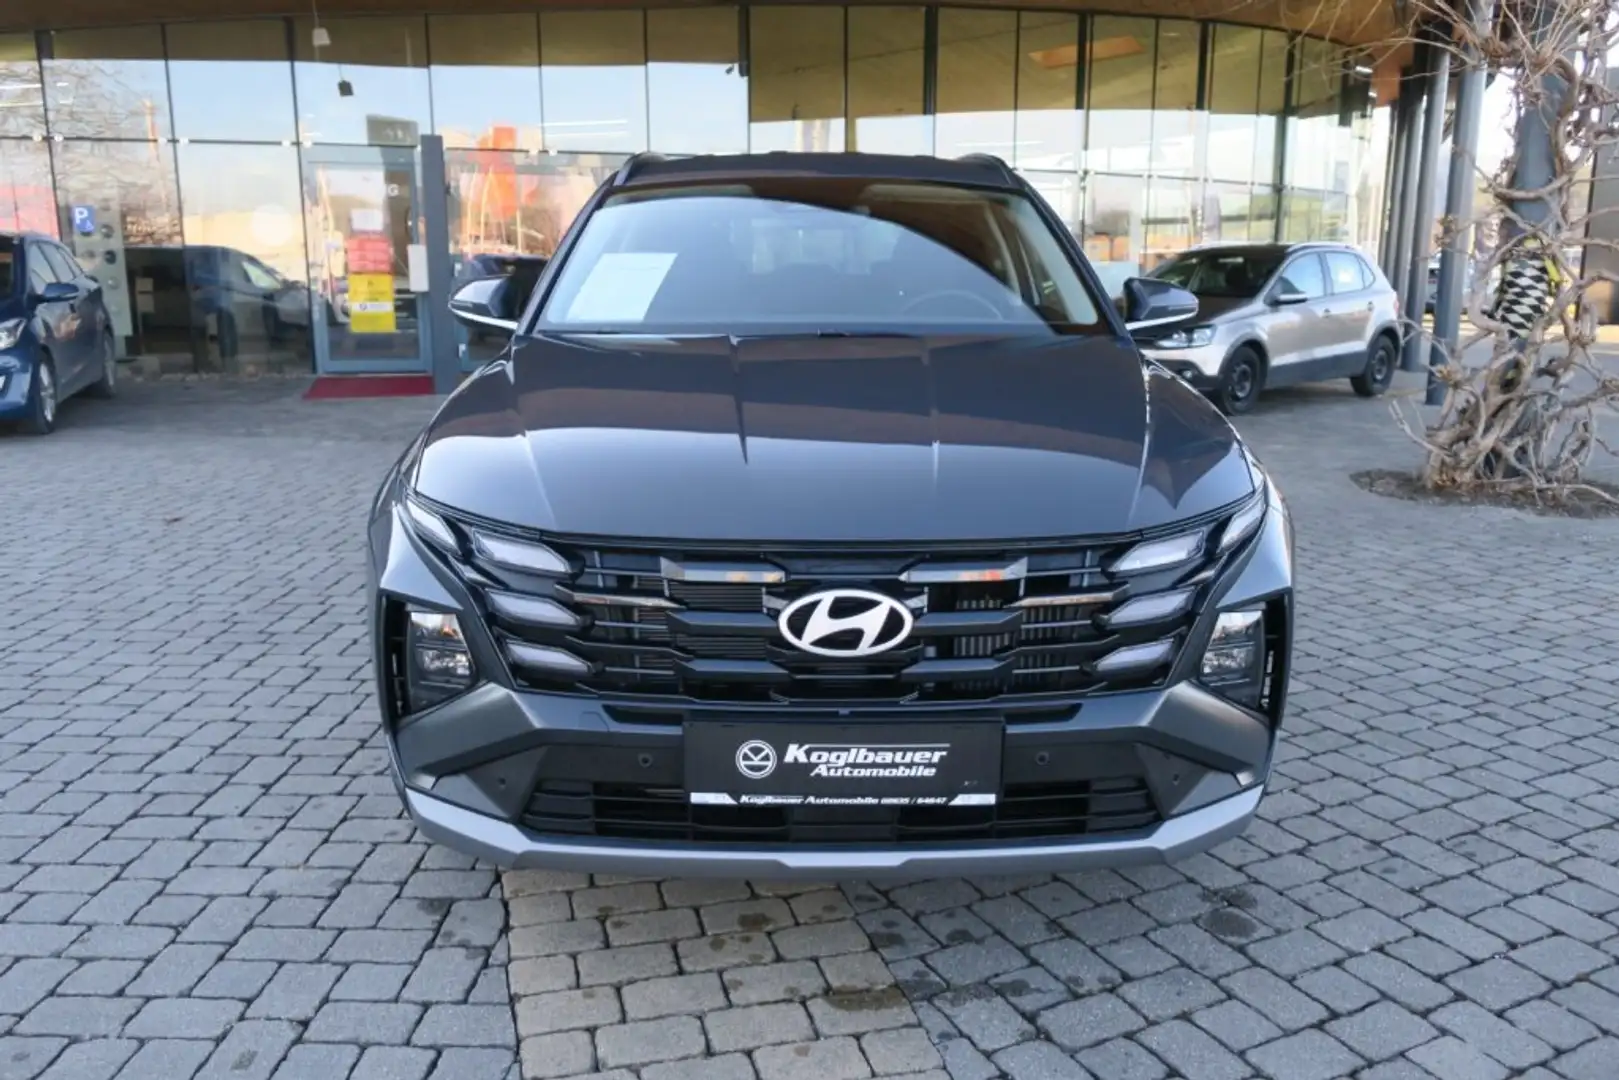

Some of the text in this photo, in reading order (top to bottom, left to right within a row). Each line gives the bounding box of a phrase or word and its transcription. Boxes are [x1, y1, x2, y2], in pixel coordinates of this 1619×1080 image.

[74, 207, 89, 225] P
[783, 743, 949, 767] Koglbauer
[810, 765, 937, 778] Automobile
[739, 794, 804, 805] Koglbauer
[804, 795, 879, 805] Automobile
